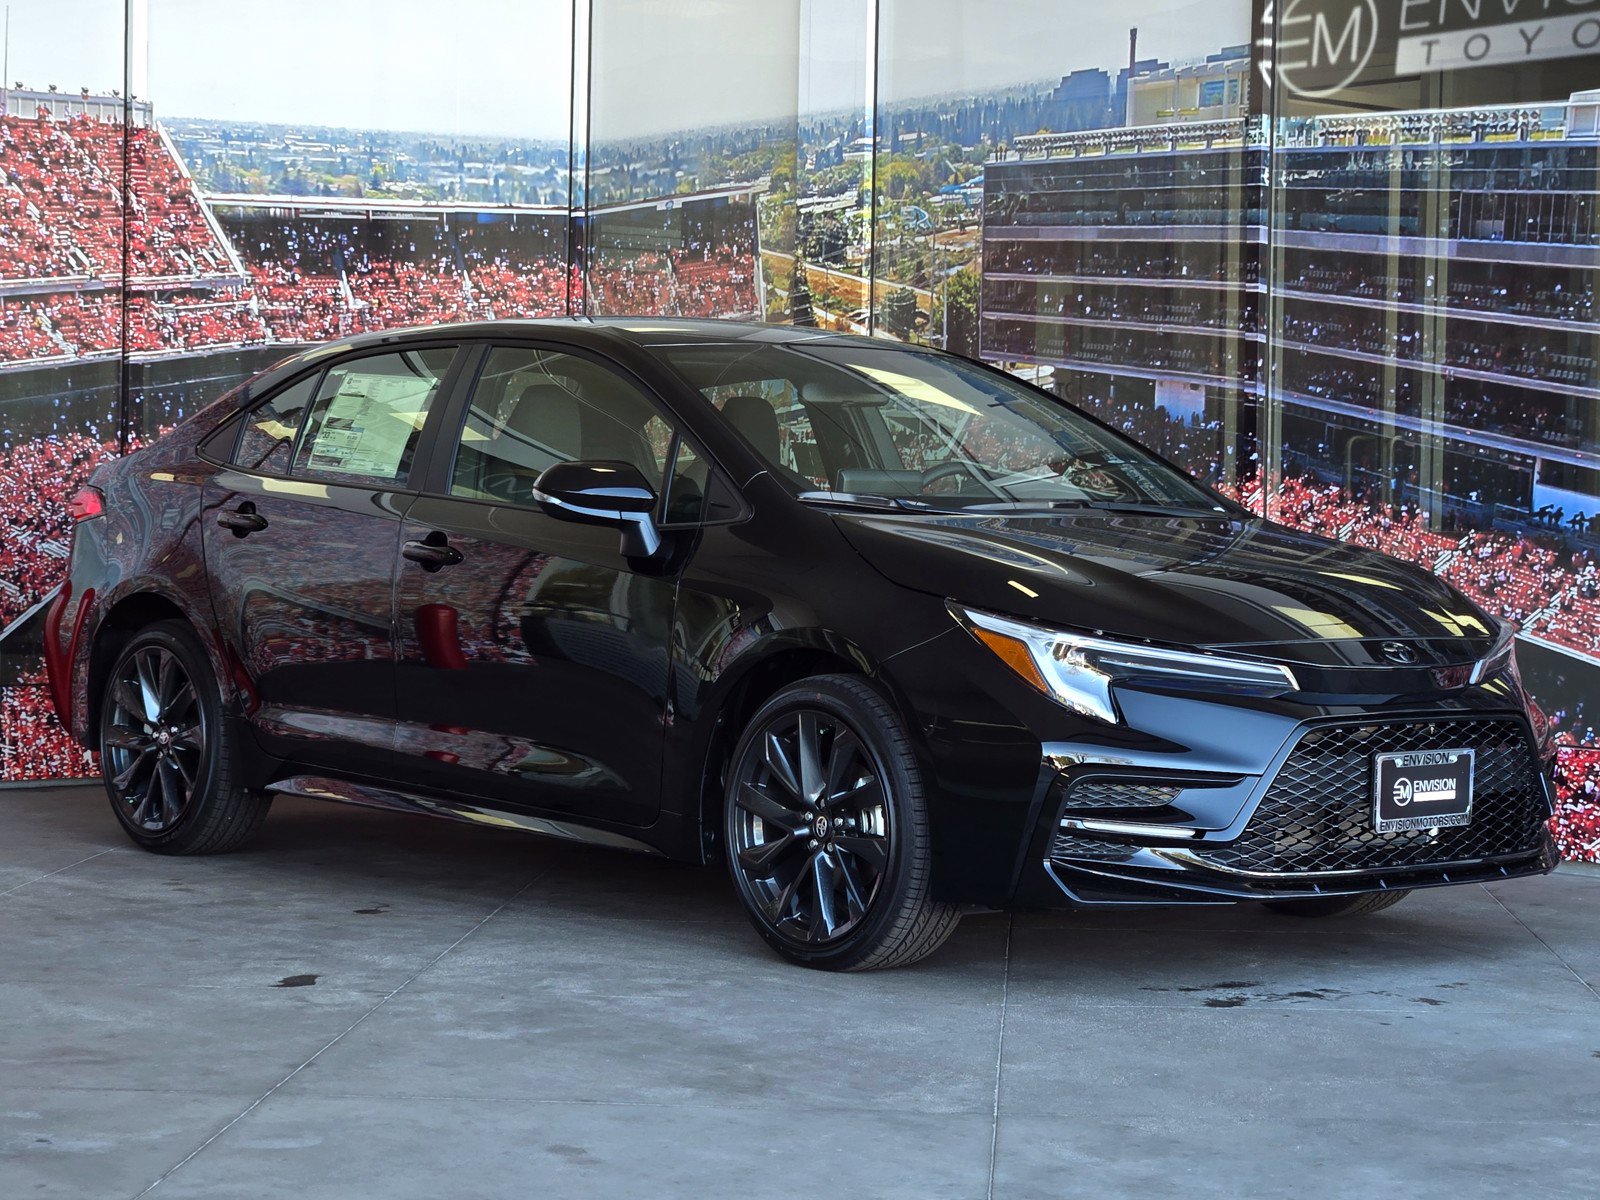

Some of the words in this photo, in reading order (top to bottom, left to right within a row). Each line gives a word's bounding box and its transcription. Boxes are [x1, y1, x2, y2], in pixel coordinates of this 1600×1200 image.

[1403, 753, 1449, 766] ENVISION
[1413, 778, 1456, 792] ENVISION
[1380, 814, 1469, 831] ENVISIONMOTORS.COM
